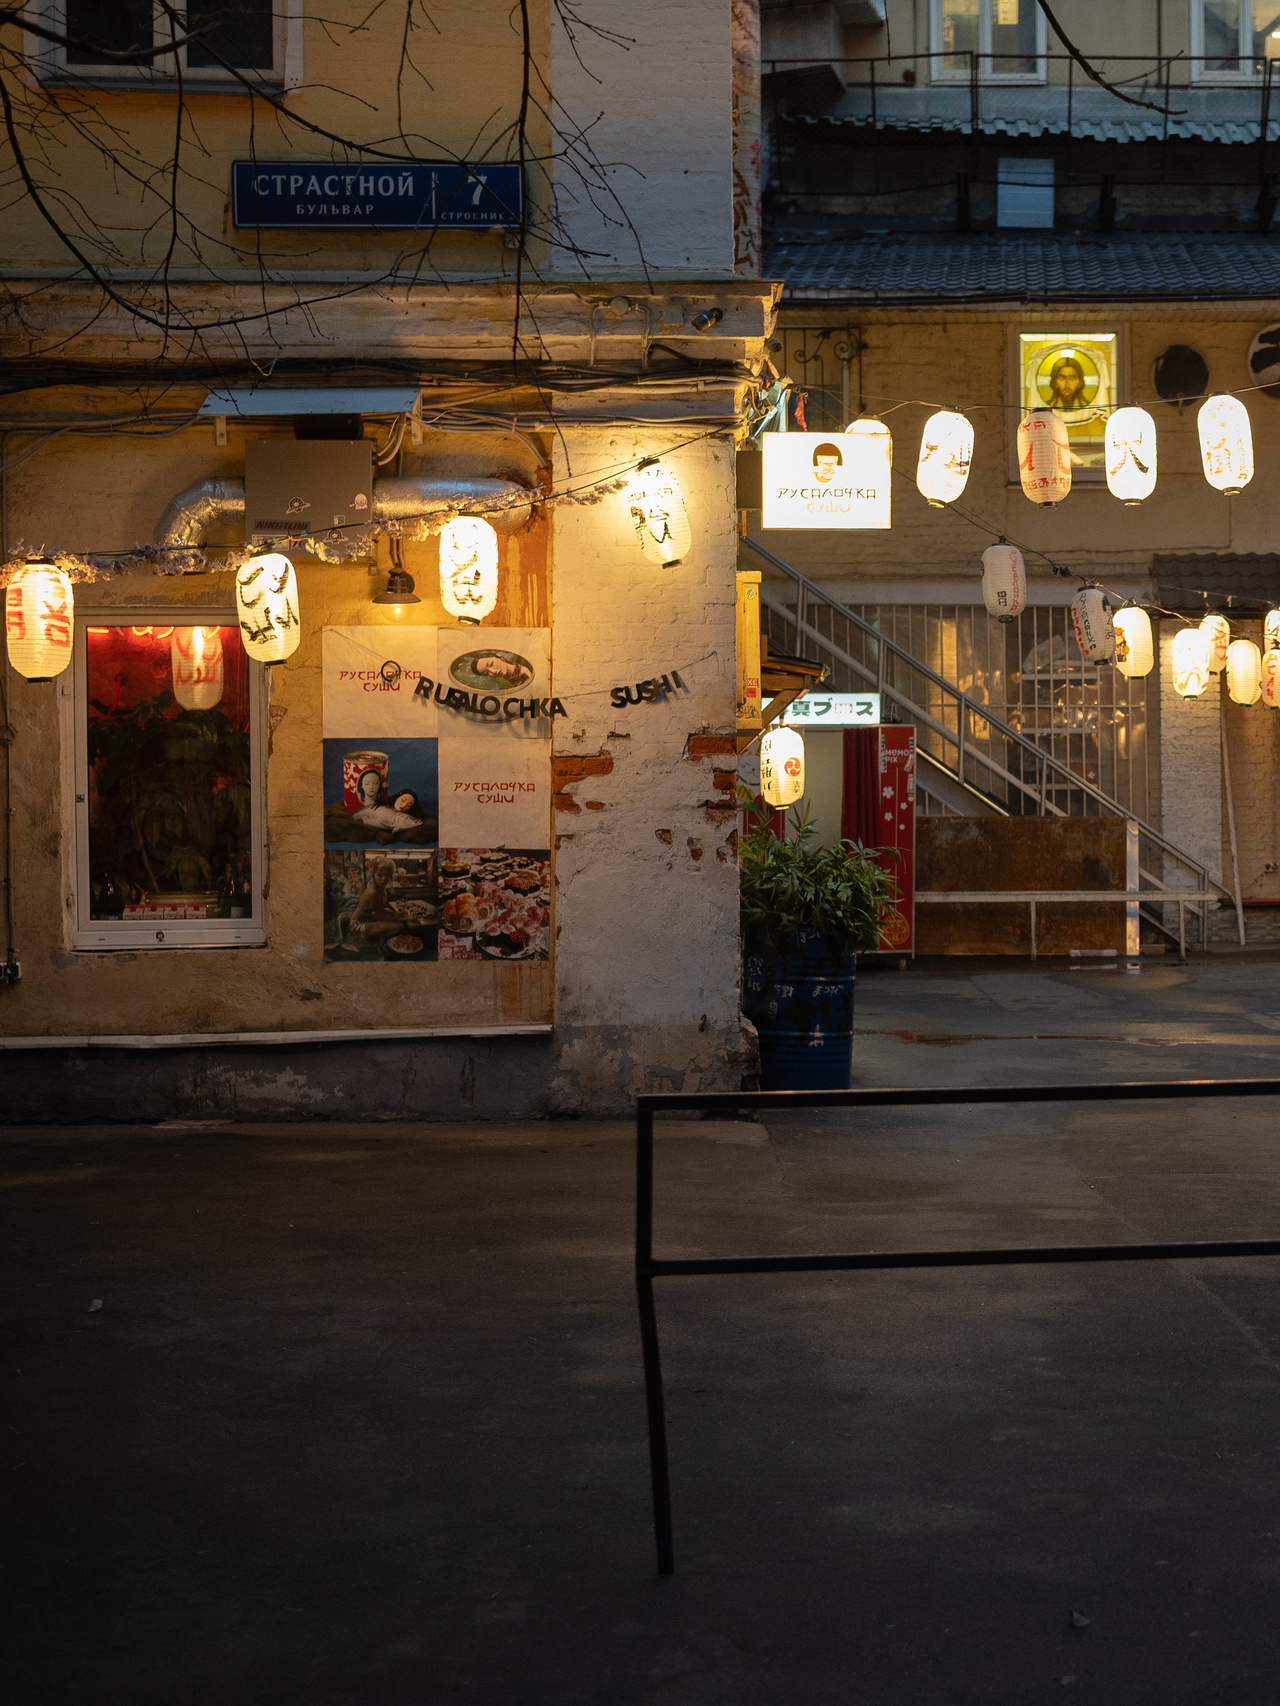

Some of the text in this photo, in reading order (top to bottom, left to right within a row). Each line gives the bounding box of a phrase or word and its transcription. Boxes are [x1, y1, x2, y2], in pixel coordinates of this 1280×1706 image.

[254, 171, 415, 197] СТРАСТНОЙ
[467, 174, 488, 206] 7
[296, 203, 375, 216] БУЛЬВАР
[777, 487, 877, 500] РУСАЛОЧКА
[362, 681, 401, 692] СУШИ
[610, 669, 683, 709] SUSHI
[453, 781, 537, 793] РУСАЛОЧКА
[476, 793, 516, 804] СУШИ
